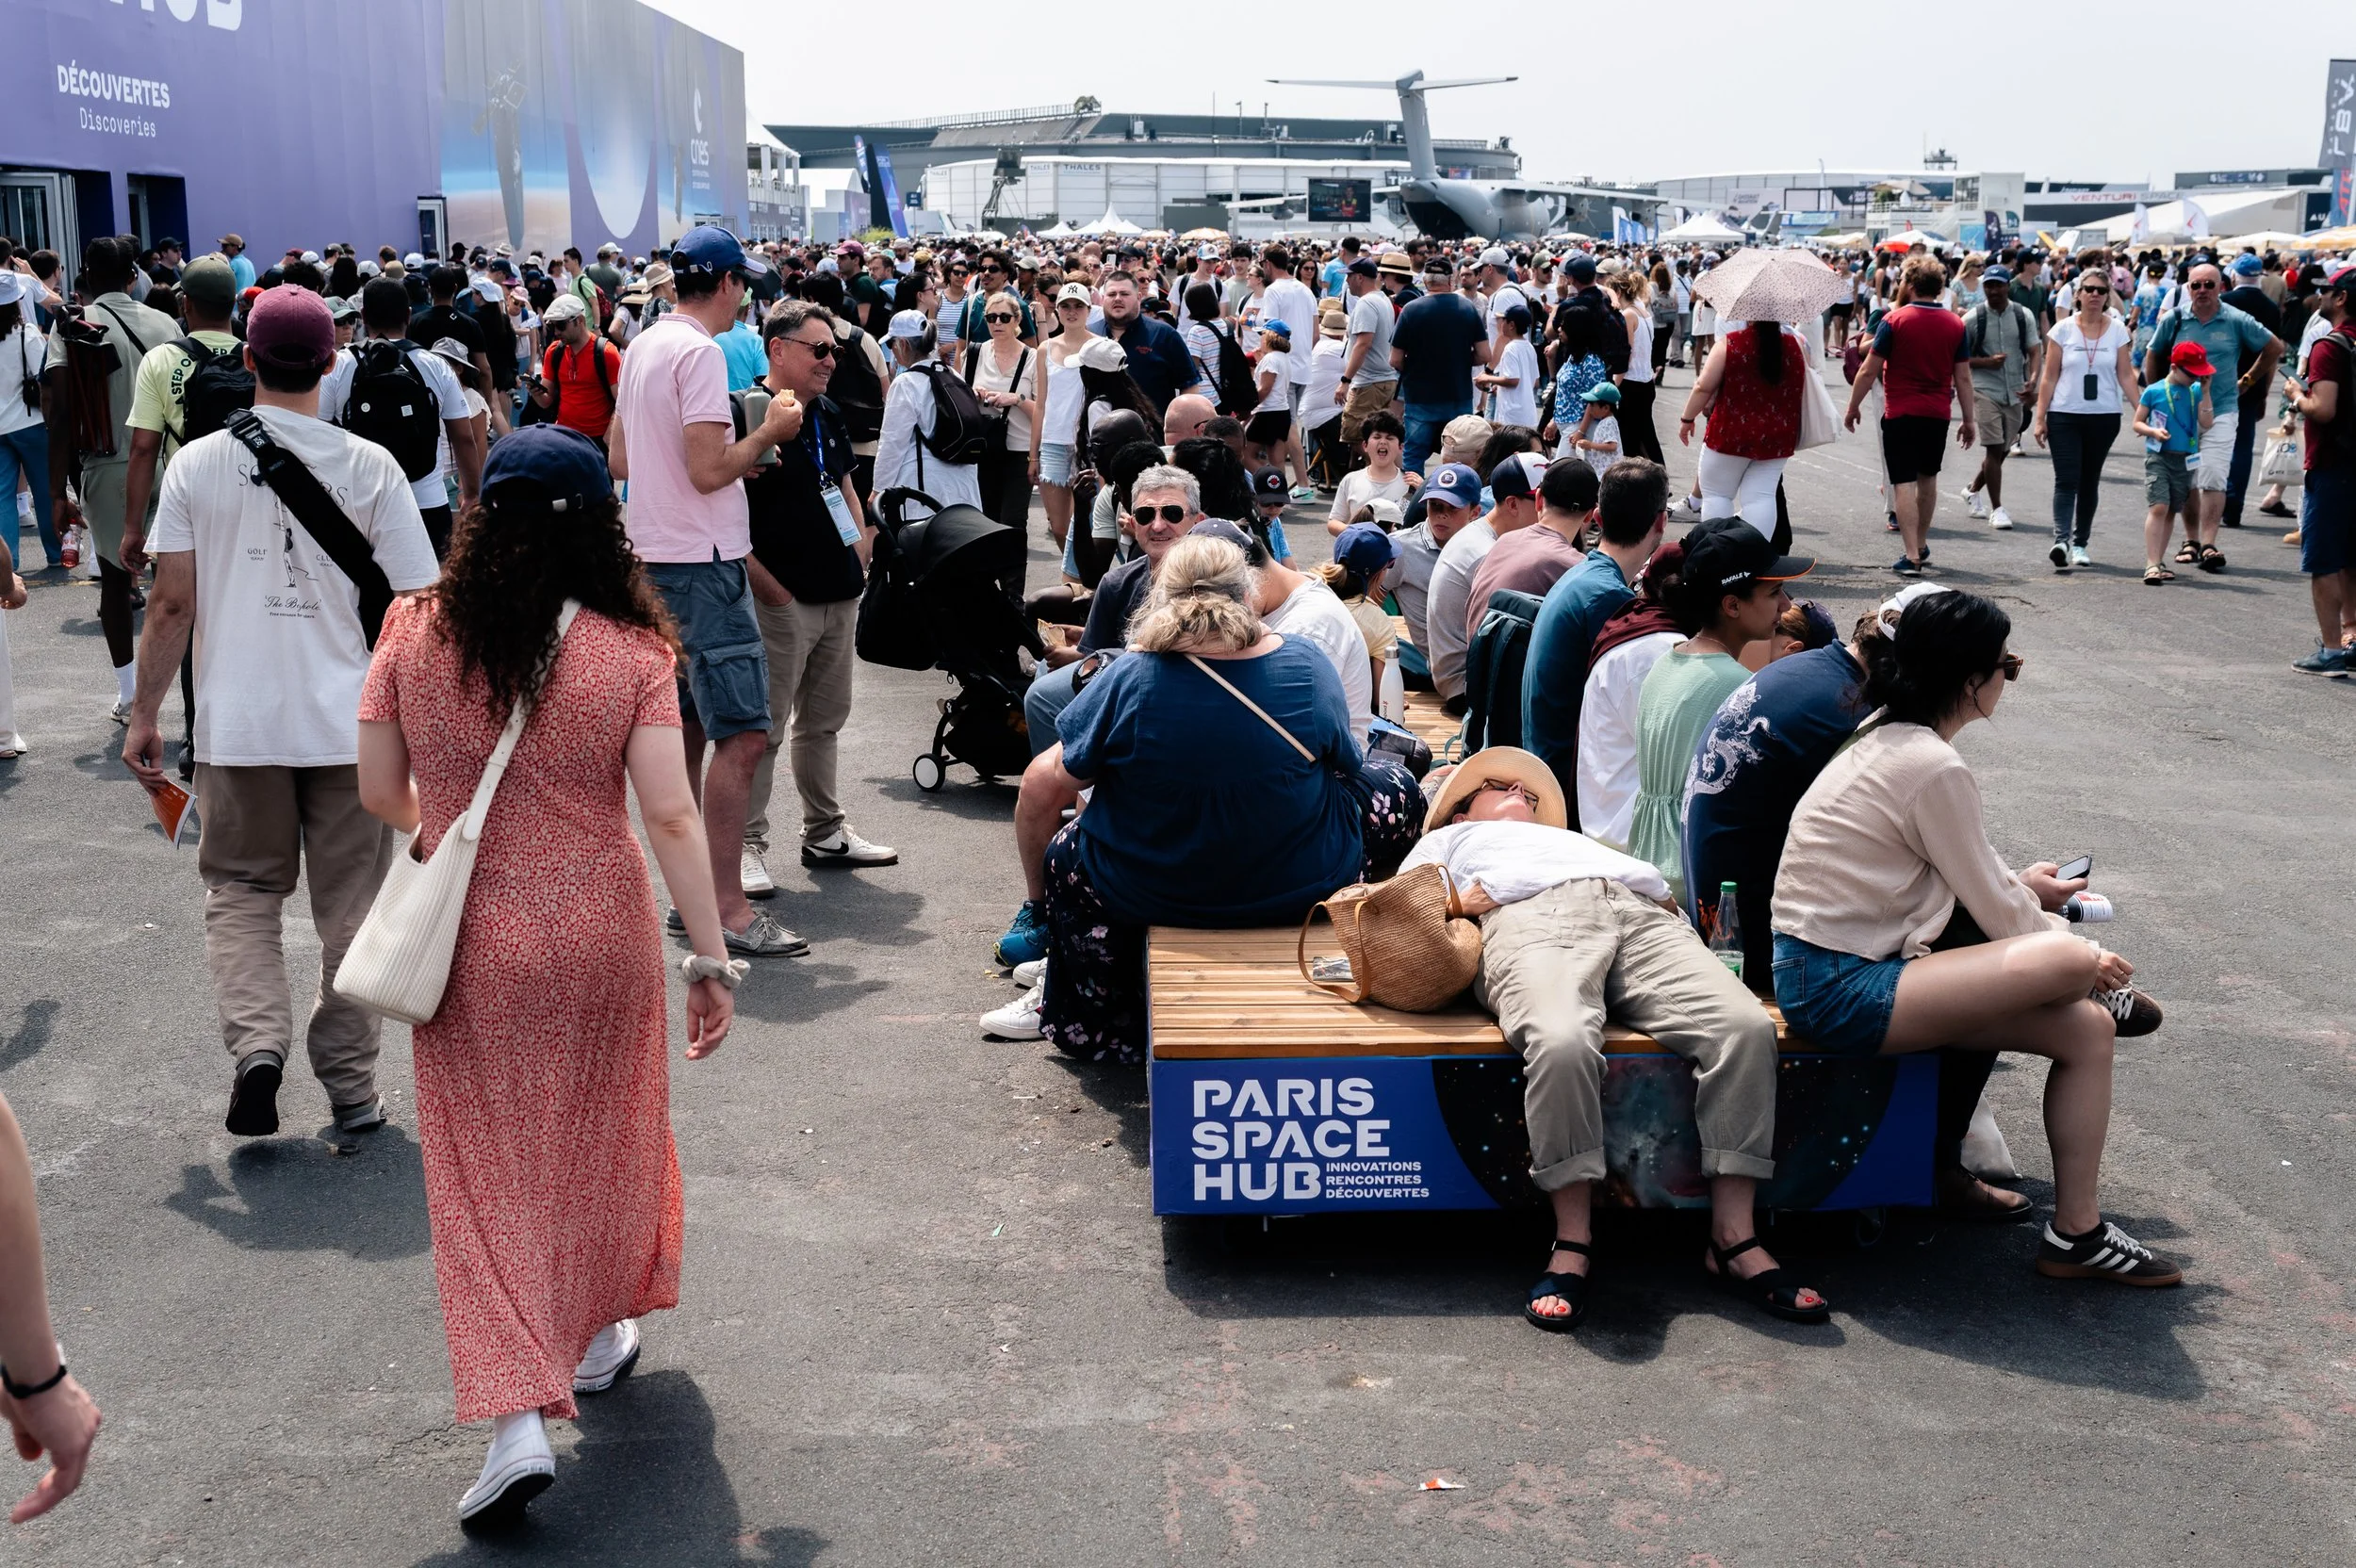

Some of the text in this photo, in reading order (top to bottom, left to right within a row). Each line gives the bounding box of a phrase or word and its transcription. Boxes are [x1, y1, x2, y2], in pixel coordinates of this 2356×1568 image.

[57, 59, 171, 108] DÉCOUVERTES
[79, 106, 156, 138] Discoveries
[2071, 192, 2136, 202] VENTURI
[171, 368, 185, 395] STEP
[1721, 572, 1742, 585] RAFALE
[1193, 1077, 1375, 1118] PARIS
[1191, 1119, 1390, 1160] SPACE
[1325, 1161, 1422, 1172] INNOVATIONS
[1325, 1174, 1422, 1185] RENCONTRES
[1193, 1161, 1321, 1200] HUB
[1325, 1186, 1430, 1199] DÉCOUVERTES
